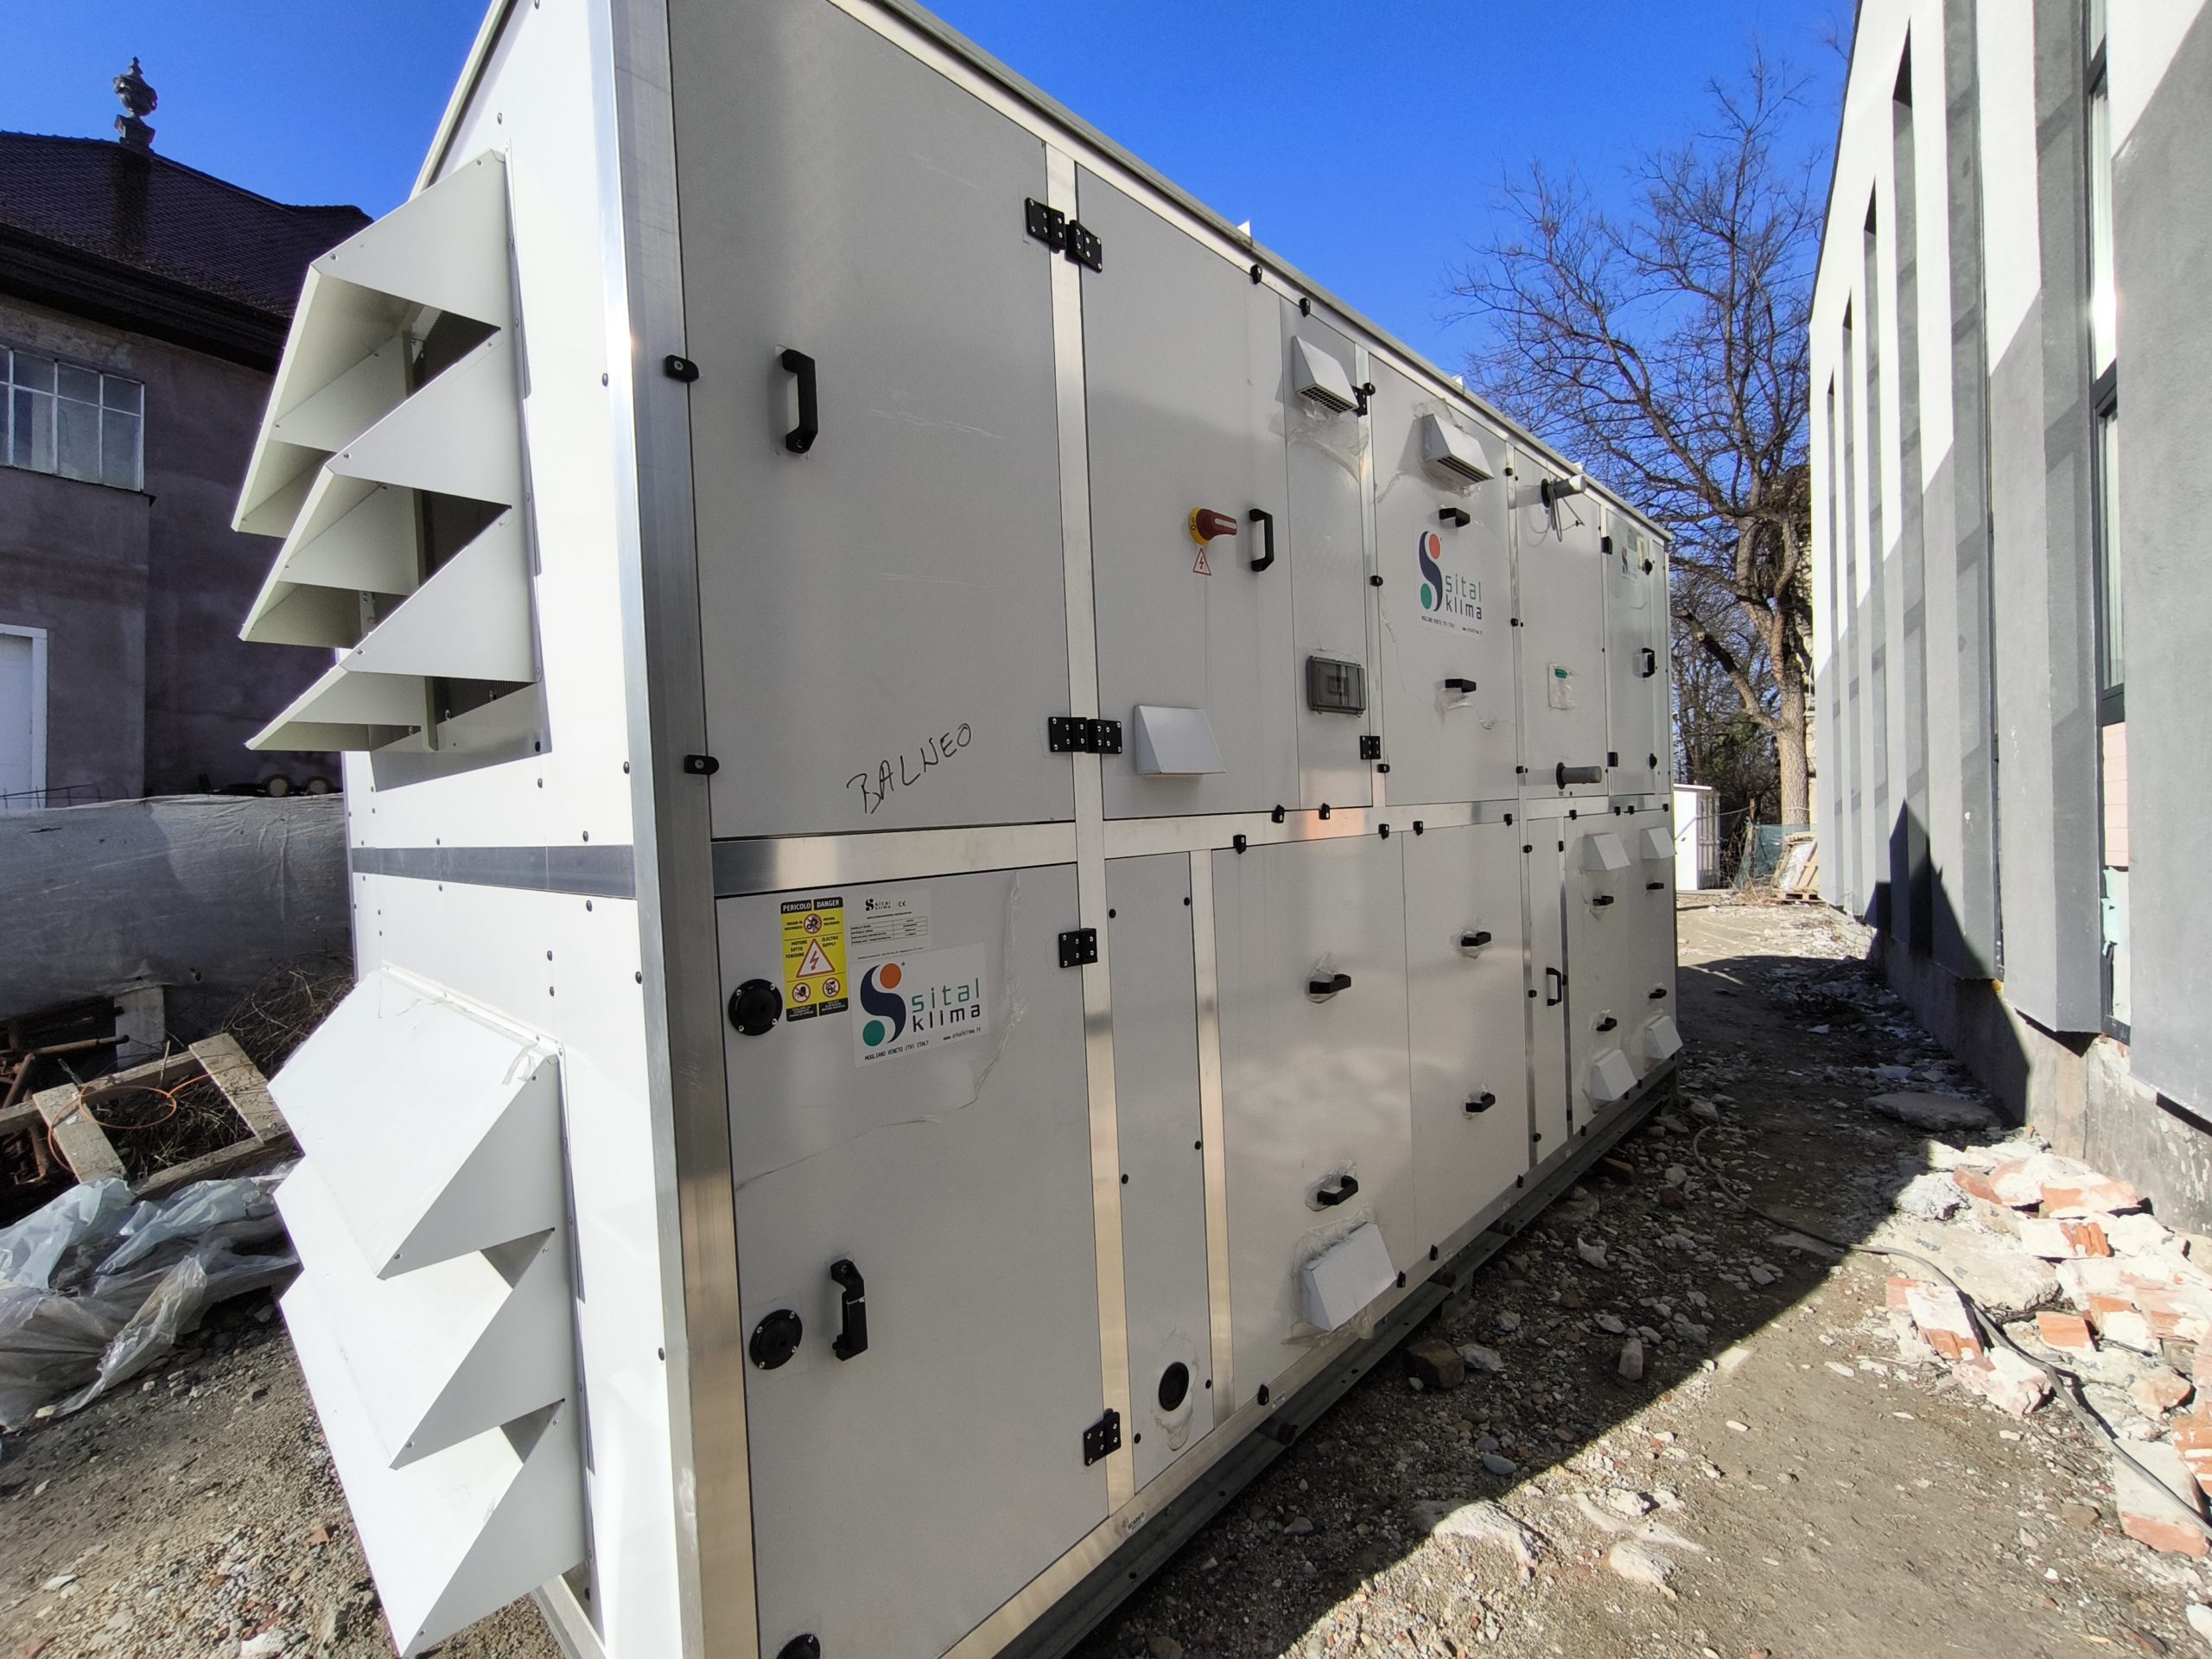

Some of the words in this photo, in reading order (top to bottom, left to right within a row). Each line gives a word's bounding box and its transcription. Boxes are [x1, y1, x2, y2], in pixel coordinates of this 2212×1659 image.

[1446, 574, 1481, 601] sital
[1446, 594, 1482, 620] klima
[846, 723, 971, 814] BALNEO
[783, 903, 811, 912] PERICOLO
[817, 899, 840, 908] DANGER
[912, 977, 979, 1014] sital
[912, 1004, 981, 1033] klima
[943, 1027, 982, 1040] www.sitalklima.it
[865, 1051, 886, 1061] MOGLIANO
[887, 1046, 904, 1055] VENETO
[917, 1039, 930, 1048] ITALY
